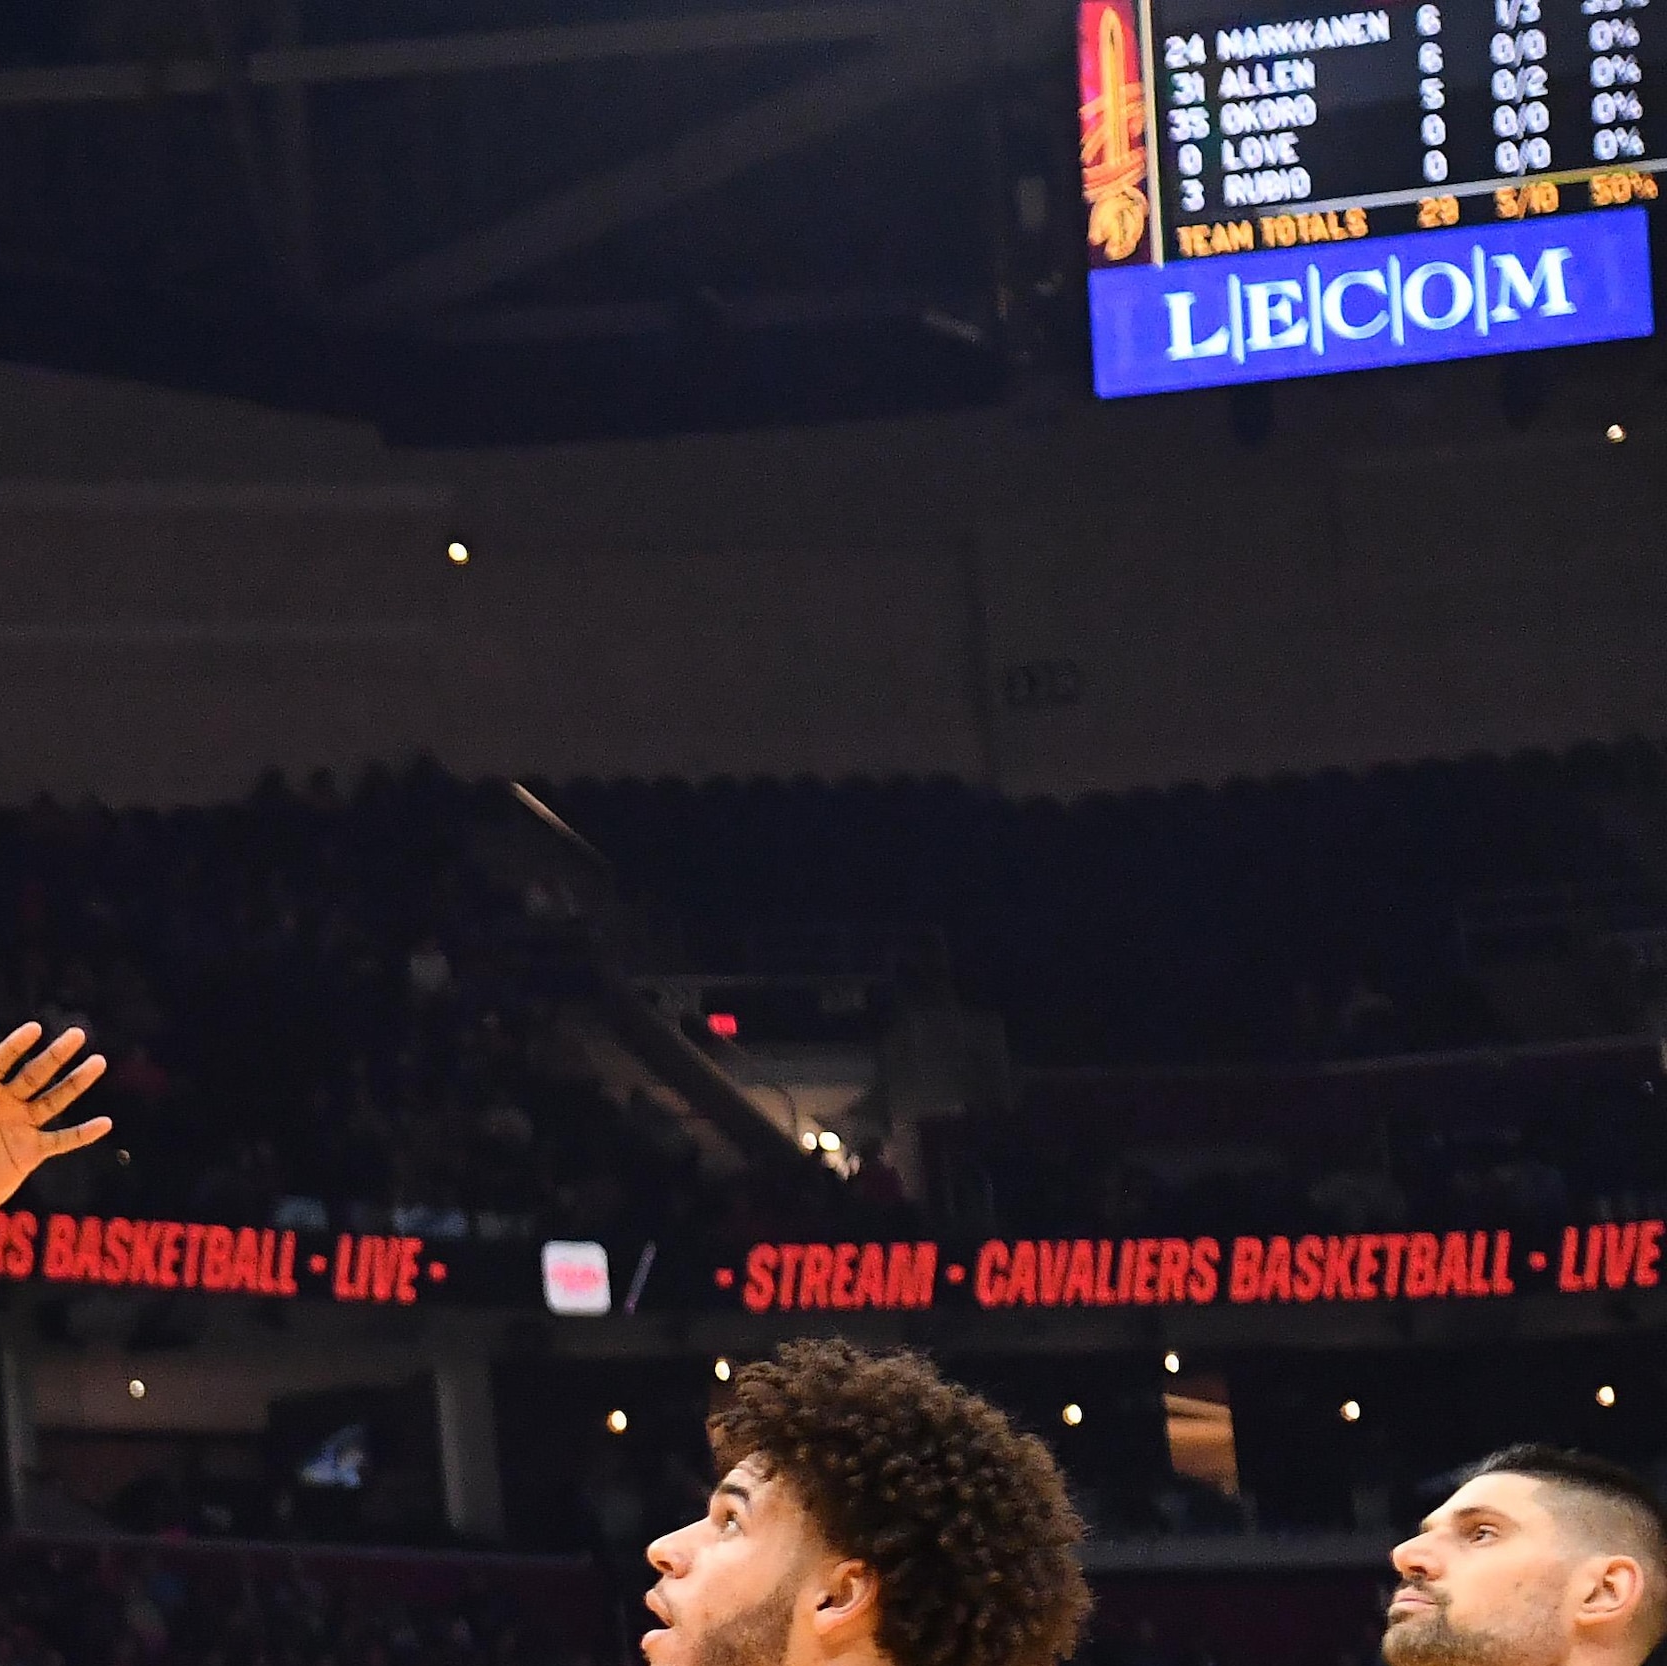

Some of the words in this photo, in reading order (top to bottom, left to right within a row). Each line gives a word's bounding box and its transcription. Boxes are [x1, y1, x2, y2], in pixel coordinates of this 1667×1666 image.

[1164, 33, 1207, 69] 24
[1215, 9, 1391, 62] MARKKANEN
[1417, 4, 1441, 36] 6
[1170, 71, 1206, 105] 31
[1218, 57, 1316, 99] ALLEN
[1418, 42, 1443, 74] 6
[1168, 106, 1210, 142] 35
[1219, 94, 1317, 135] OKORO
[1178, 143, 1202, 176] 0
[1221, 131, 1299, 171] LOVE
[1421, 114, 1446, 146] 0
[1180, 178, 1205, 212] 3
[1223, 166, 1311, 207] RUBIO
[1423, 150, 1448, 182] 0
[1176, 220, 1255, 257] TEAM
[1260, 207, 1369, 248] TOTALS
[41, 1214, 297, 1296] BASKETBALL
[331, 1233, 421, 1304] LIVE
[743, 1240, 938, 1312] STREAM
[971, 1234, 1218, 1309] CAVALIERS
[1227, 1229, 1514, 1302] BASKETBALL
[1558, 1219, 1663, 1293] LIVE
